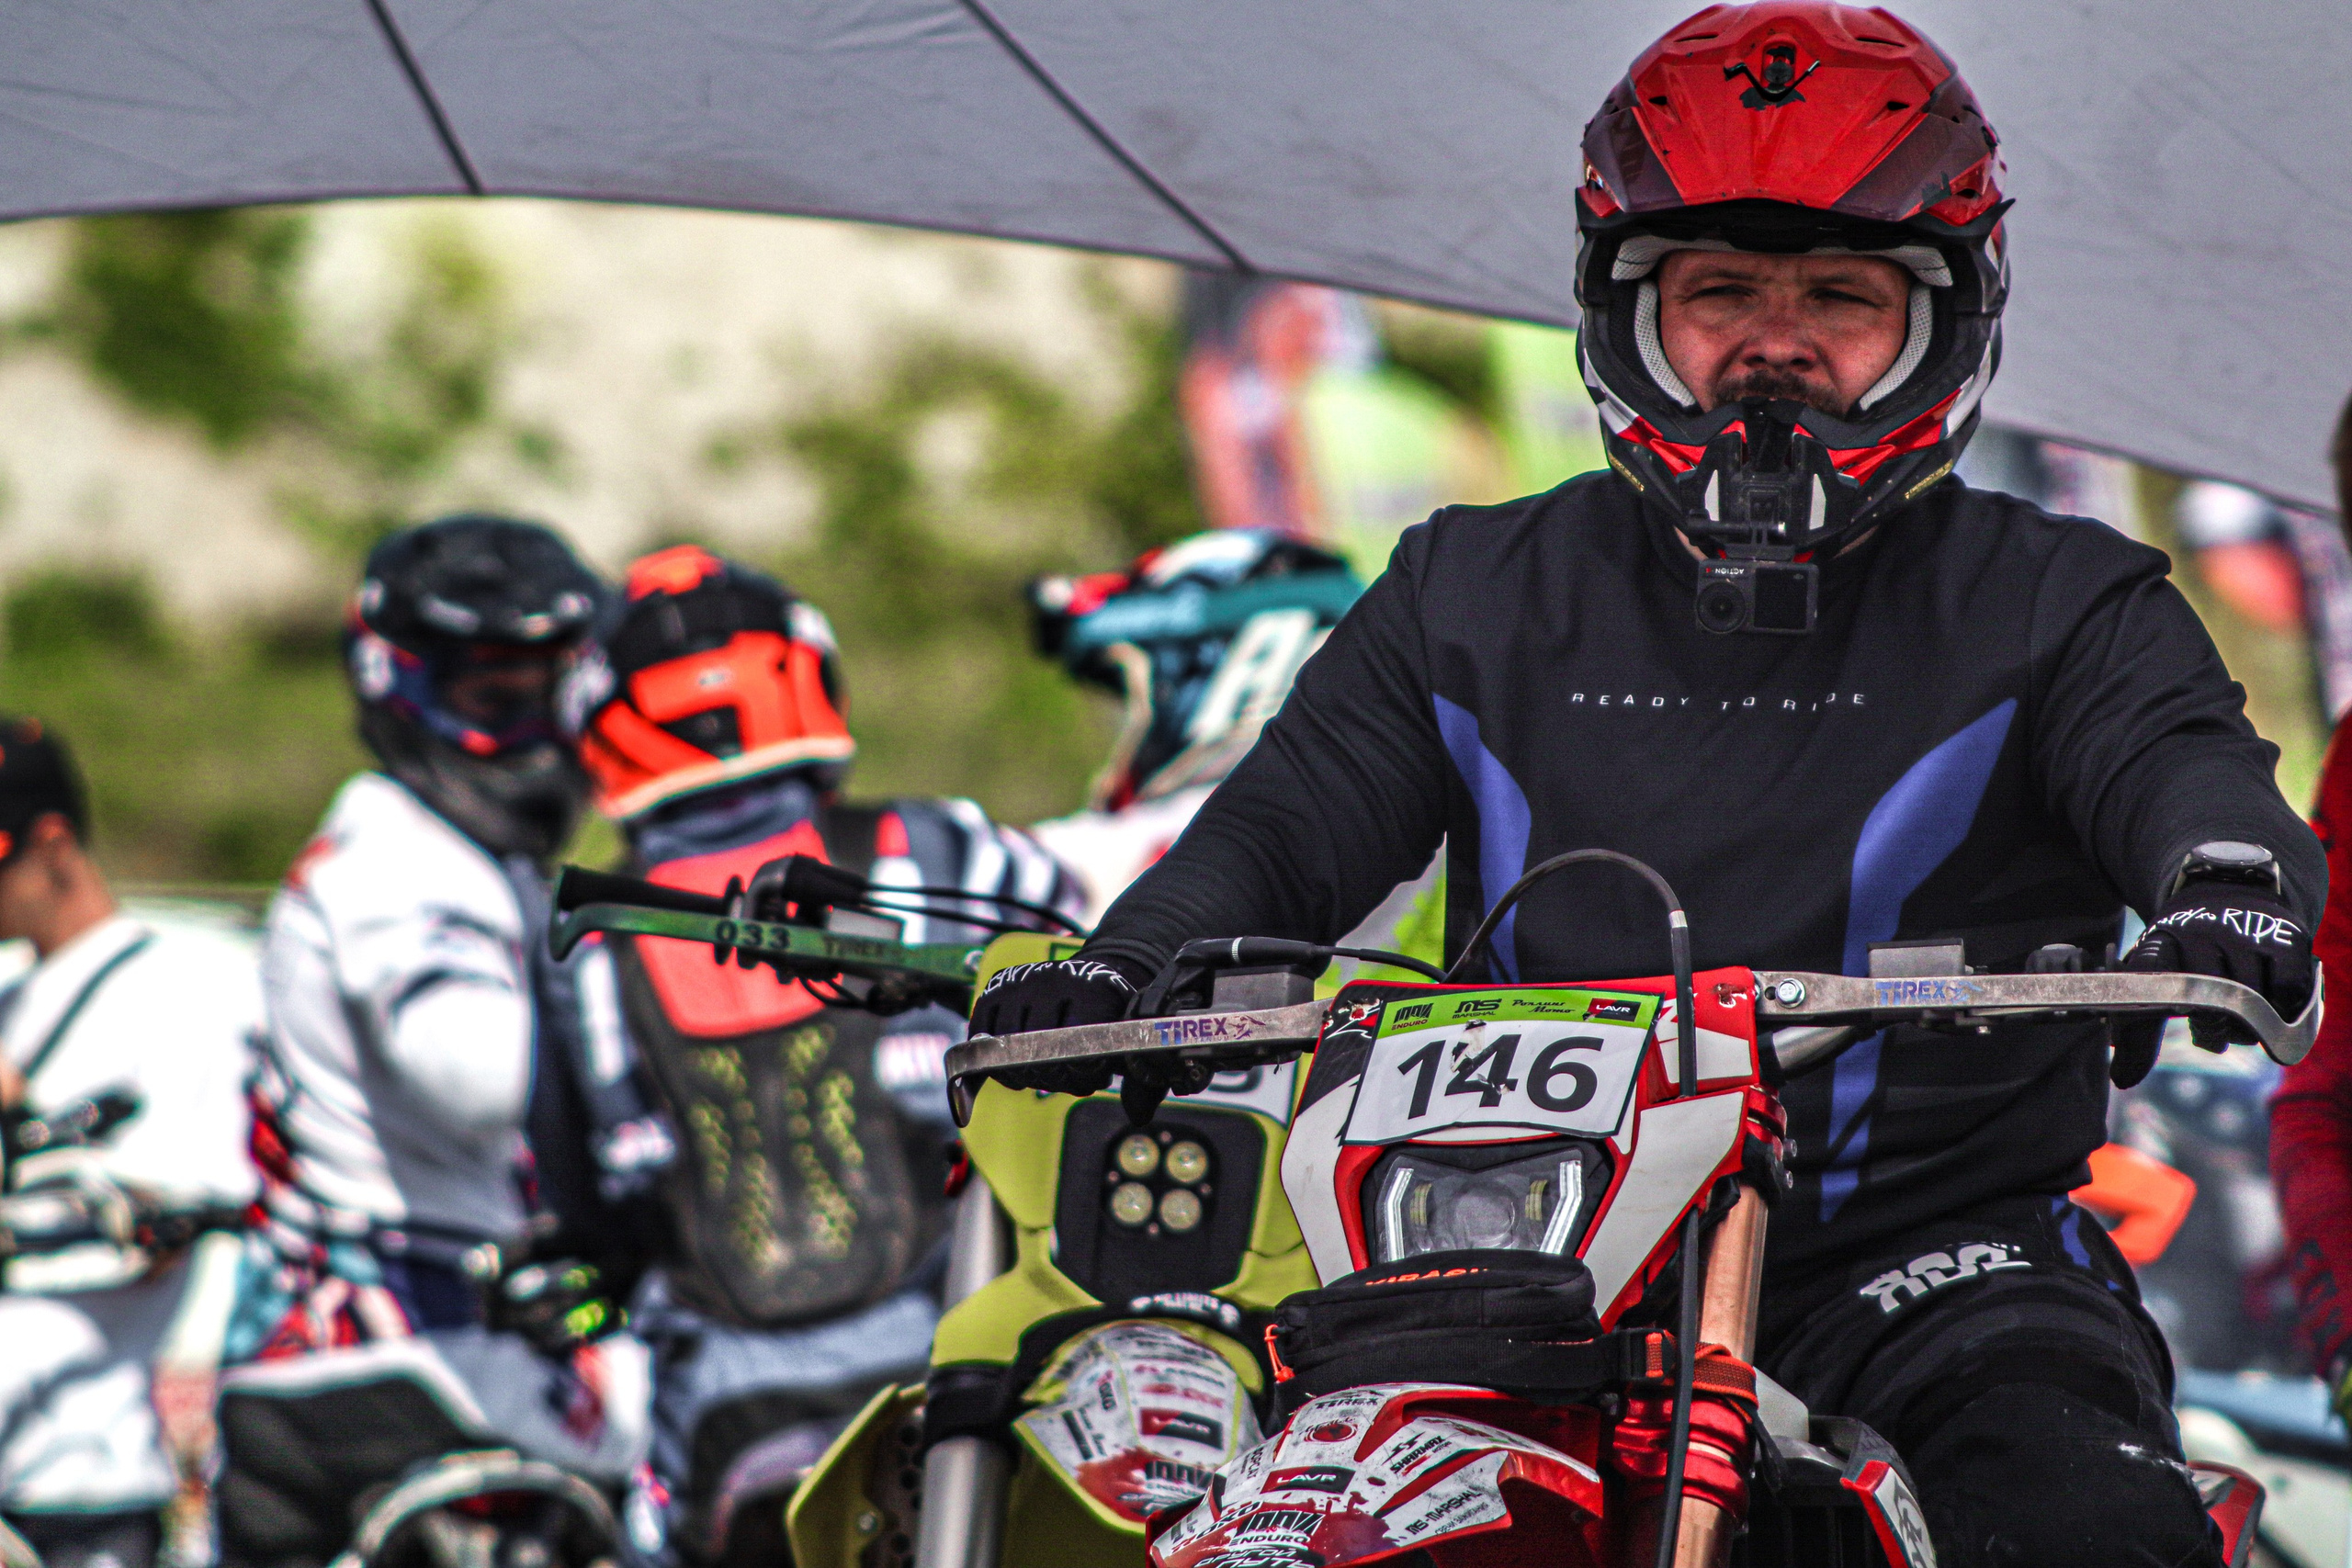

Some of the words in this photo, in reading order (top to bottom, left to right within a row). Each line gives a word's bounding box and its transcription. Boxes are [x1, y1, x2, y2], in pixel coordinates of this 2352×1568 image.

[1714, 567, 1745, 575] ACTION
[1572, 693, 1689, 706] READY
[1722, 696, 1755, 710] TO
[1783, 693, 1865, 712] RIDE
[2222, 908, 2302, 945] RIDE
[1595, 1004, 1631, 1013] LAVR
[1452, 1011, 1497, 1020] MARSHAL
[1391, 1019, 1429, 1031] ENDURO
[1397, 1033, 1604, 1120] 146
[1389, 1435, 1447, 1474] SHARMAX
[1276, 1473, 1337, 1484] LAVR
[1229, 1534, 1309, 1548] ENDURO
